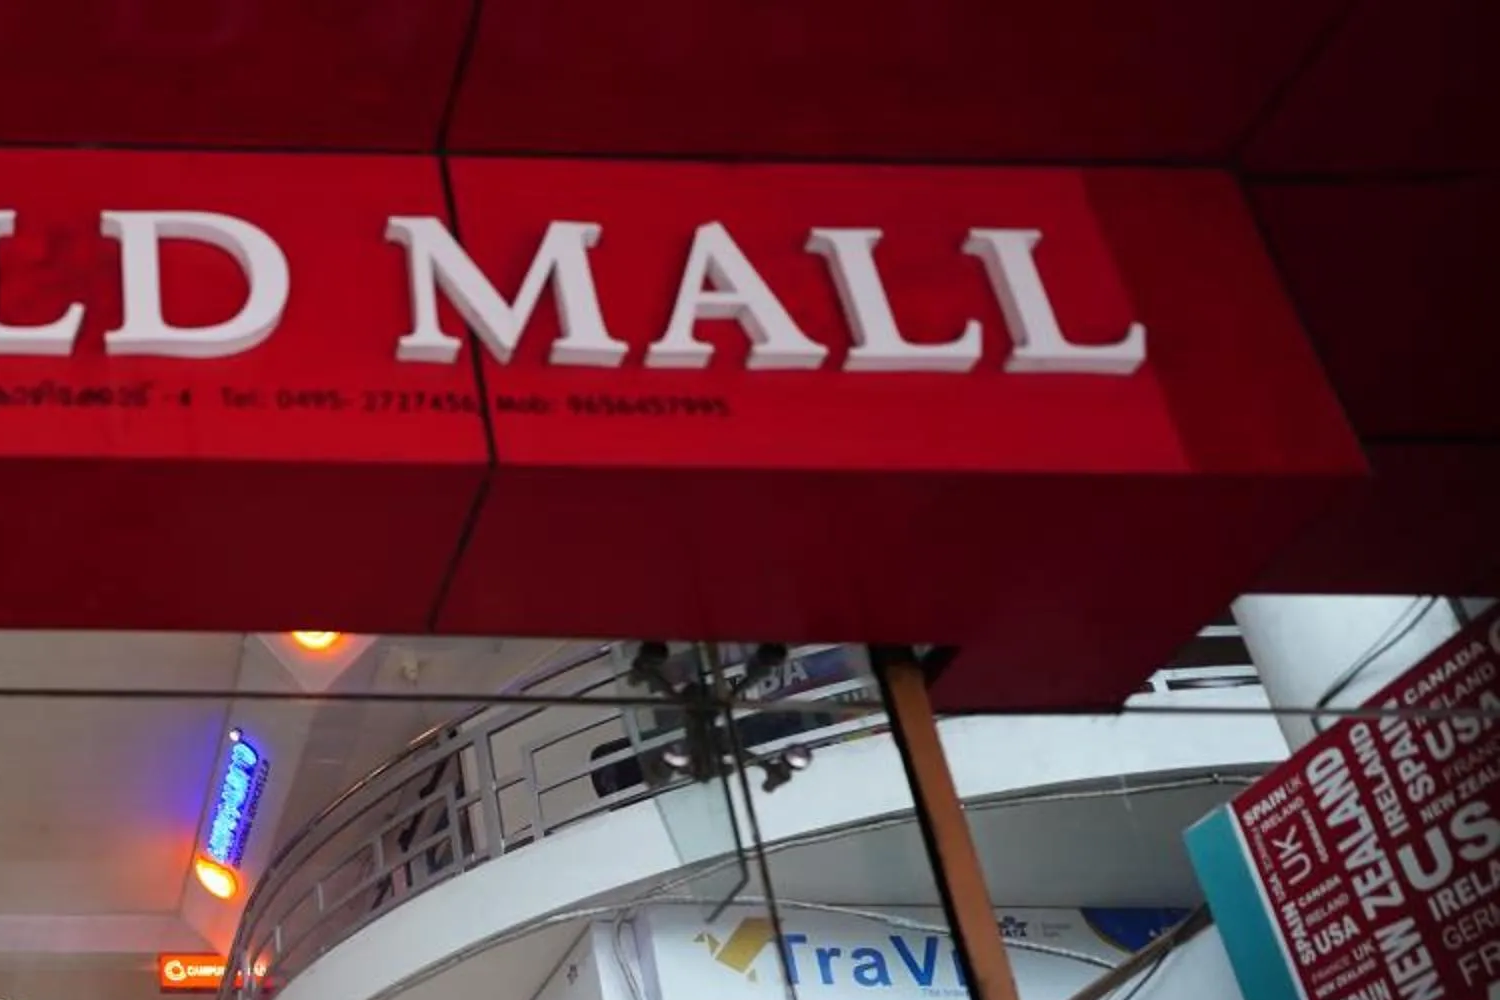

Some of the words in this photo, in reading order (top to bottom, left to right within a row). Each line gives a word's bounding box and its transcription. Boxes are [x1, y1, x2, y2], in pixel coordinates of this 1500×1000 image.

[385, 215, 1147, 374] MALL
[1403, 641, 1486, 705] CANADA
[1348, 722, 1411, 838] IRELAND
[1378, 697, 1436, 803] SPAIN
[1270, 823, 1313, 887] UK
[1305, 746, 1405, 922] ZEALAND
[780, 932, 968, 987] TraVi
[1312, 914, 1361, 956] USA
